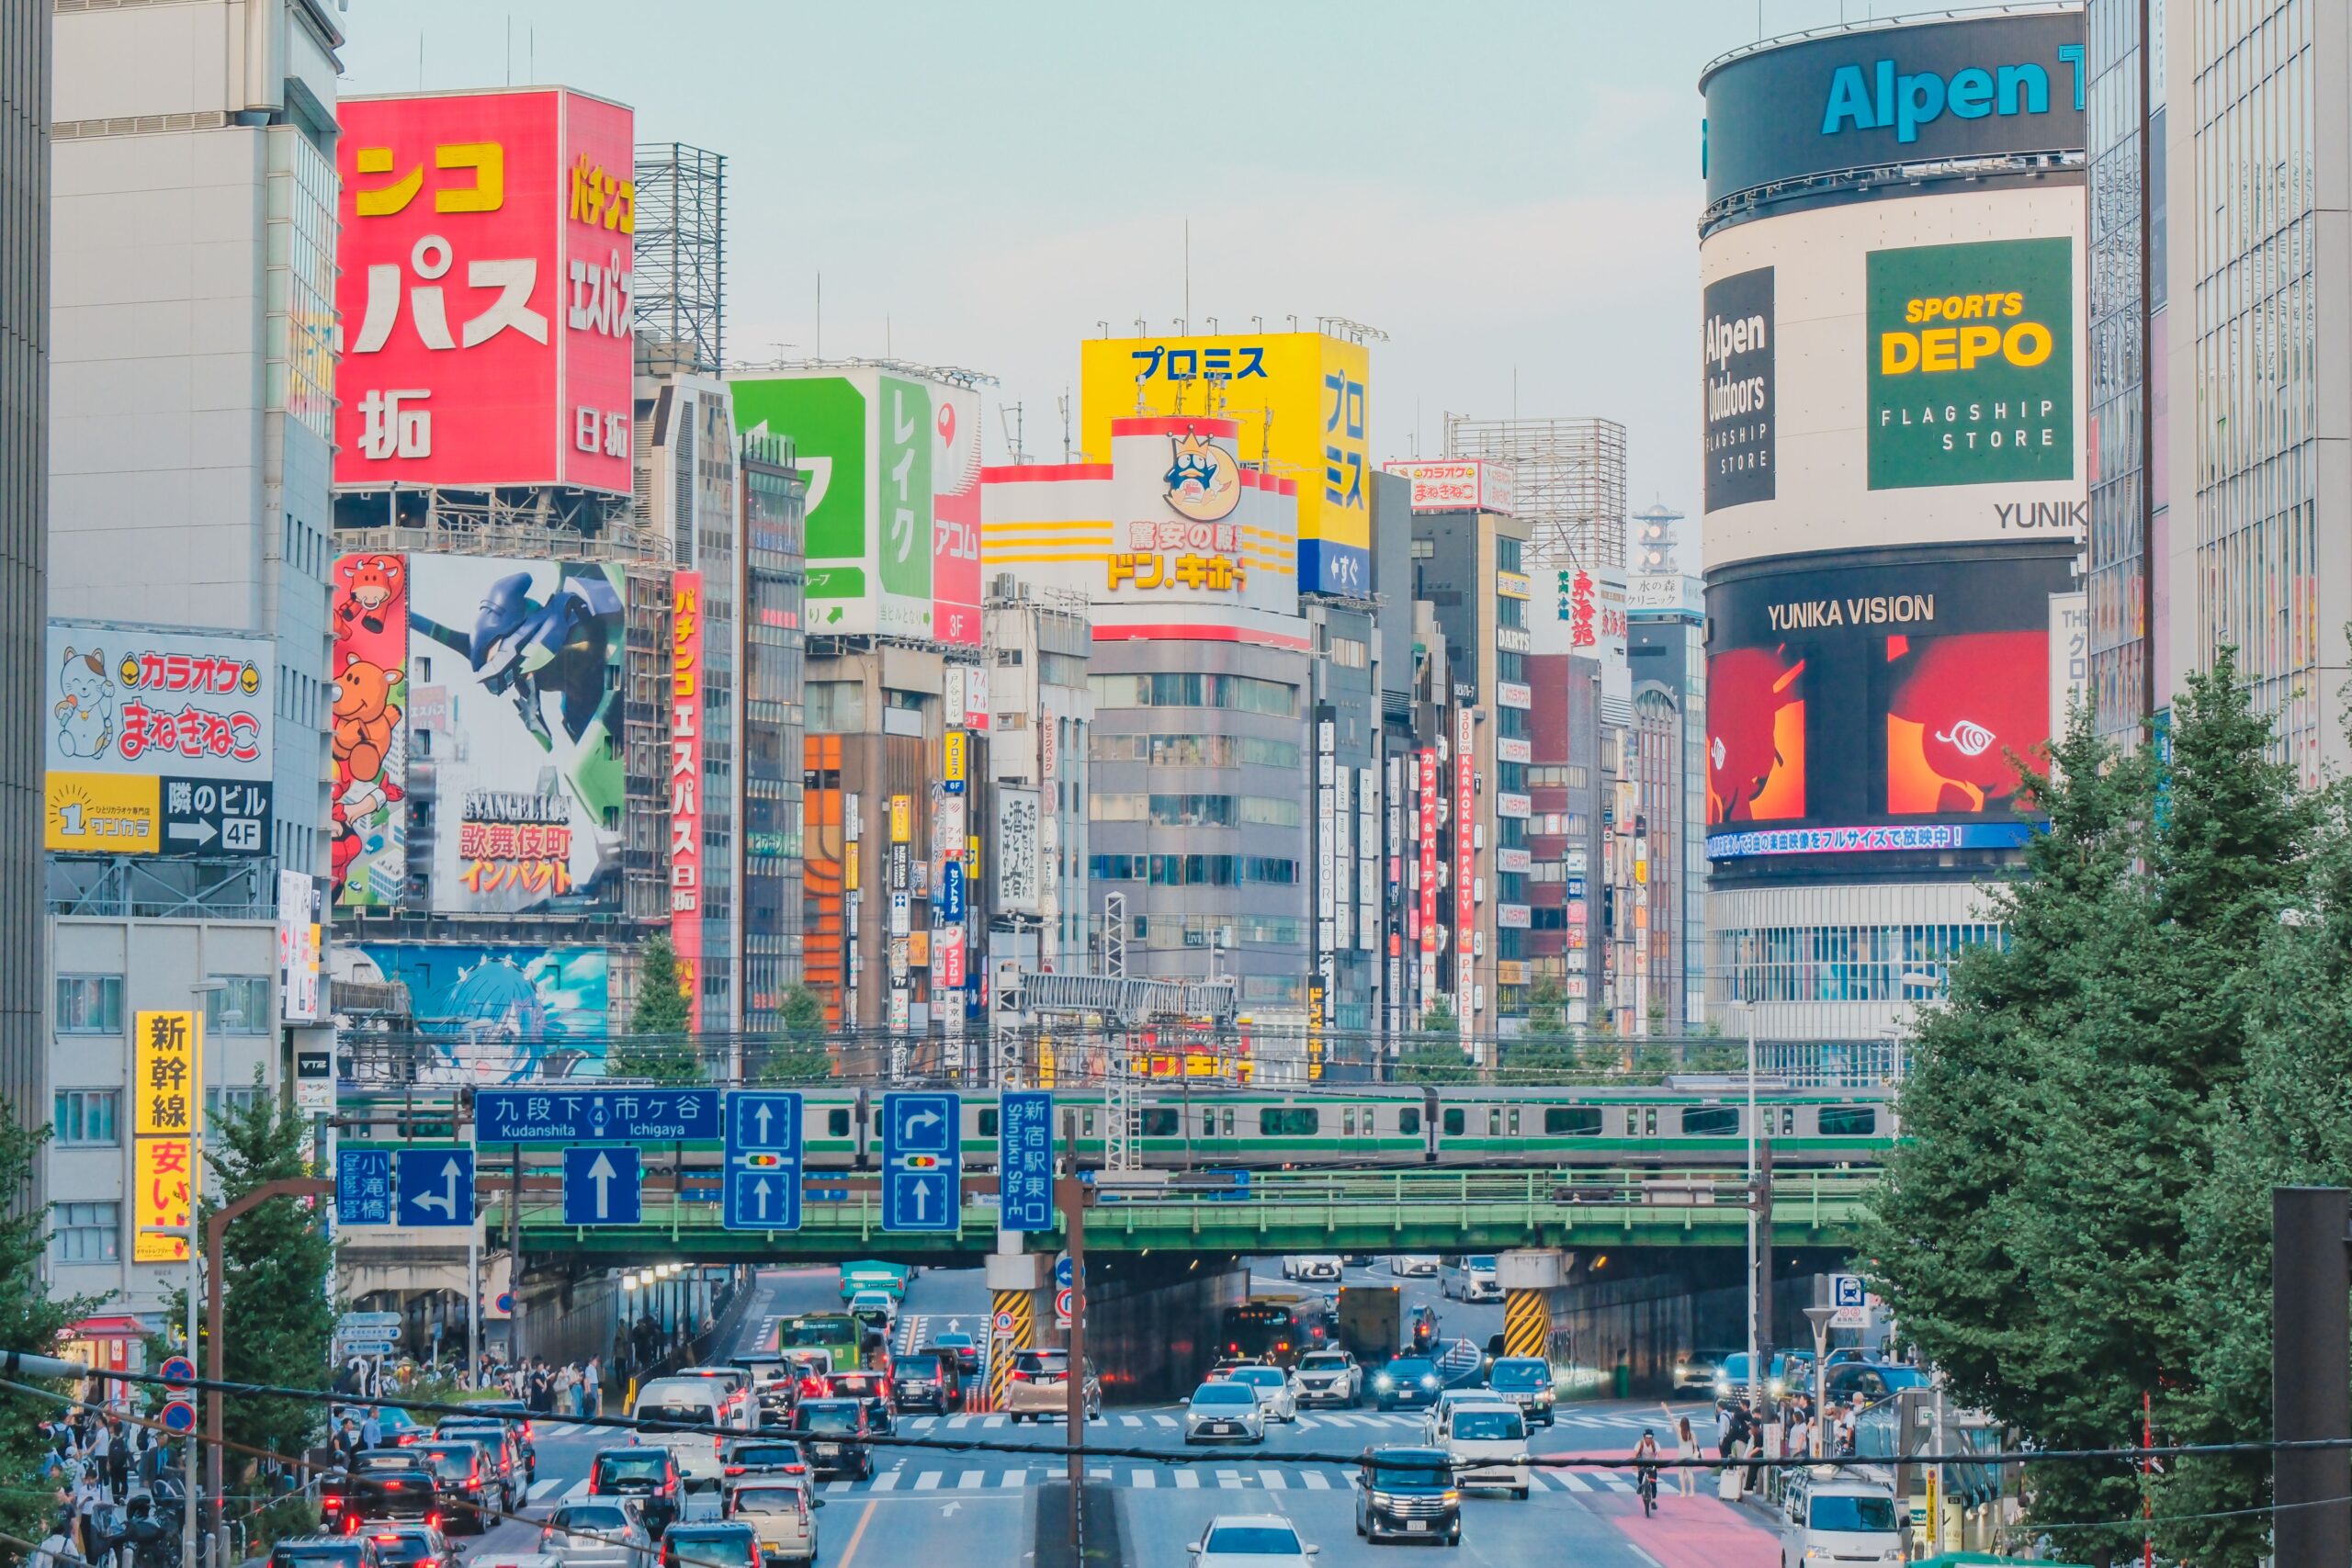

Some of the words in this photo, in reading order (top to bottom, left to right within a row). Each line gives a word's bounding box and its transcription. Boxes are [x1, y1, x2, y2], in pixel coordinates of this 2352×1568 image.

[1821, 60, 2049, 143] Alpen
[356, 141, 504, 217] ンコ
[570, 152, 635, 234] パチンコ
[352, 234, 548, 353] パス
[570, 248, 635, 340] エスパス
[1905, 292, 2023, 323] SPORTS
[1705, 313, 1765, 371] Alpen
[1882, 322, 2052, 376] DEPO
[1132, 345, 1269, 382] プロミス
[1708, 373, 1765, 423] Outdoors
[1882, 400, 2053, 427] FLAGSHIP
[576, 405, 628, 458] 日拓
[1706, 423, 1767, 453] FLAGSHIP
[1942, 429, 2053, 451] STORE
[890, 389, 916, 563] レイク
[1423, 467, 1466, 479] カラオケ
[1721, 451, 1767, 476] STORE
[1413, 483, 1475, 502] まねきねこ
[935, 519, 978, 562] アコム
[1339, 555, 1359, 586] すぐ
[1639, 579, 1676, 592] 水の森
[949, 615, 964, 637] 3F
[1570, 569, 1596, 647] 東海苑
[1768, 600, 1843, 631] YUNIKA
[1847, 594, 1935, 624] VISION
[673, 588, 696, 696] パチンコ
[1498, 628, 1530, 651] DARTS
[137, 651, 243, 694] カラオケ
[118, 697, 262, 762] まねきねこ
[168, 782, 266, 817] 隣のビル
[673, 705, 695, 854] エスパス
[1462, 756, 1470, 833] KARAOKE
[96, 806, 151, 816] ひとりカラオケ専門店
[461, 791, 573, 824] EVANGELION
[90, 818, 151, 838] ワンカラ
[227, 823, 256, 845] 4F
[460, 823, 573, 860] 歌舞伎町
[459, 860, 572, 894] インパクト
[673, 865, 696, 911] 日拓
[950, 868, 959, 914] セントラル
[1462, 857, 1470, 909] PARTY
[949, 949, 958, 976] アコム
[151, 1015, 187, 1128] 新幹線
[495, 1096, 582, 1122] 九段下
[594, 1110, 604, 1123] 4
[502, 1123, 576, 1137] Kudanshita
[629, 1123, 685, 1137] Ichigaya
[1008, 1104, 1023, 1165] Shinjuku
[1023, 1100, 1046, 1223] 新宿駅東口
[362, 1155, 386, 1220] 小滝橋
